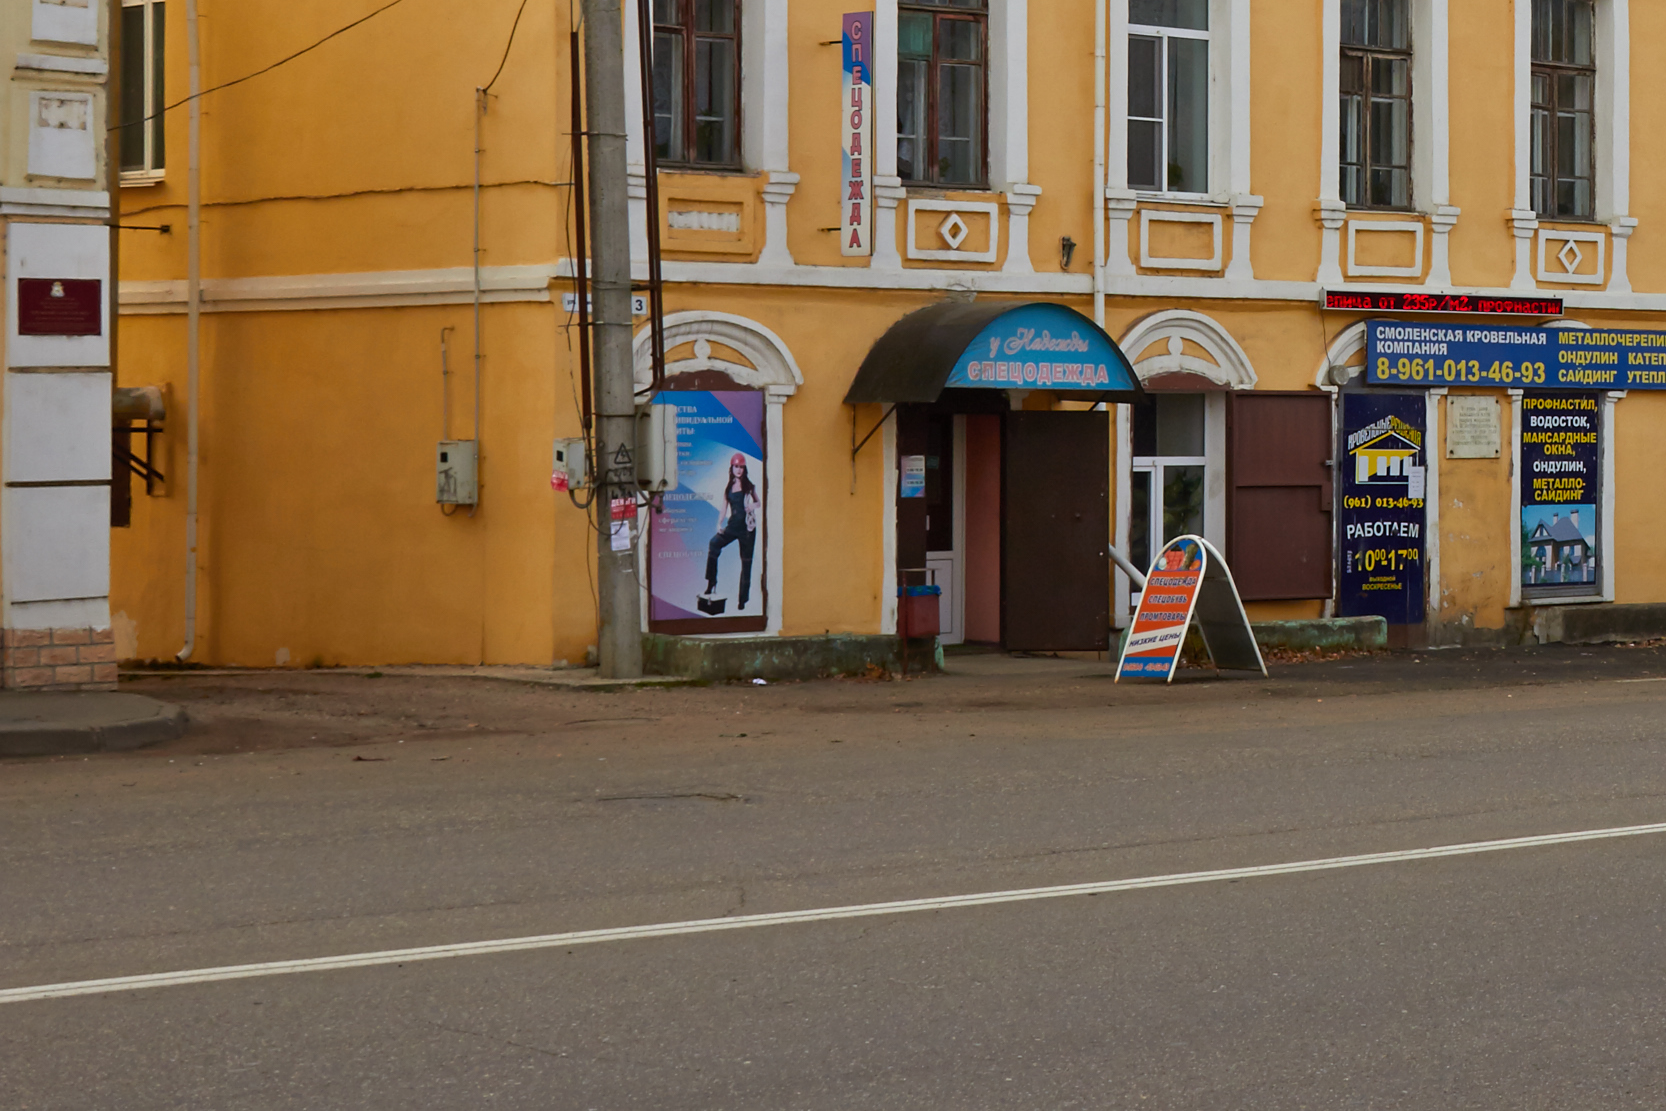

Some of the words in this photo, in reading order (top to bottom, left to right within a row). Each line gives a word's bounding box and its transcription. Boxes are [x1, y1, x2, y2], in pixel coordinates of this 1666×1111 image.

[848, 20, 864, 248] СПЕЦОДЕЖДА
[635, 299, 643, 311] 3
[1379, 297, 1396, 309] от
[1004, 327, 1089, 355] Надежды
[1376, 326, 1463, 342] СМОЛЕНСКАЯ
[1466, 330, 1547, 345] КРОВЕЛЬНАЯ
[1376, 341, 1448, 355] КОМПАНИЯ
[1558, 350, 1618, 366] ОНДУЛИН
[968, 361, 1109, 386] СПЕЦОДЕЖДА
[1376, 357, 1546, 384] 8-961-013-46-93
[1558, 367, 1617, 384] САЙДИНГ
[1523, 398, 1598, 412] ПРОФНАСТИЛ,
[1530, 415, 1590, 429] ВОДОСТОК,
[1523, 432, 1597, 444] МАНСАРДНЫЕ
[1543, 444, 1575, 457] ОКНА,
[1533, 460, 1587, 474] ОНДУЛИН,
[1533, 478, 1586, 489] МЕТАЛЛО-
[1343, 495, 1371, 509] (961)
[1375, 497, 1424, 508] 013-46-93
[1534, 489, 1584, 502] САЙДИНГ
[1346, 521, 1419, 539] РАБОТАЕМ
[1149, 577, 1197, 588] СПЕЦОДЕЖДА
[1148, 594, 1188, 605] СПЕЦОБУВЬ
